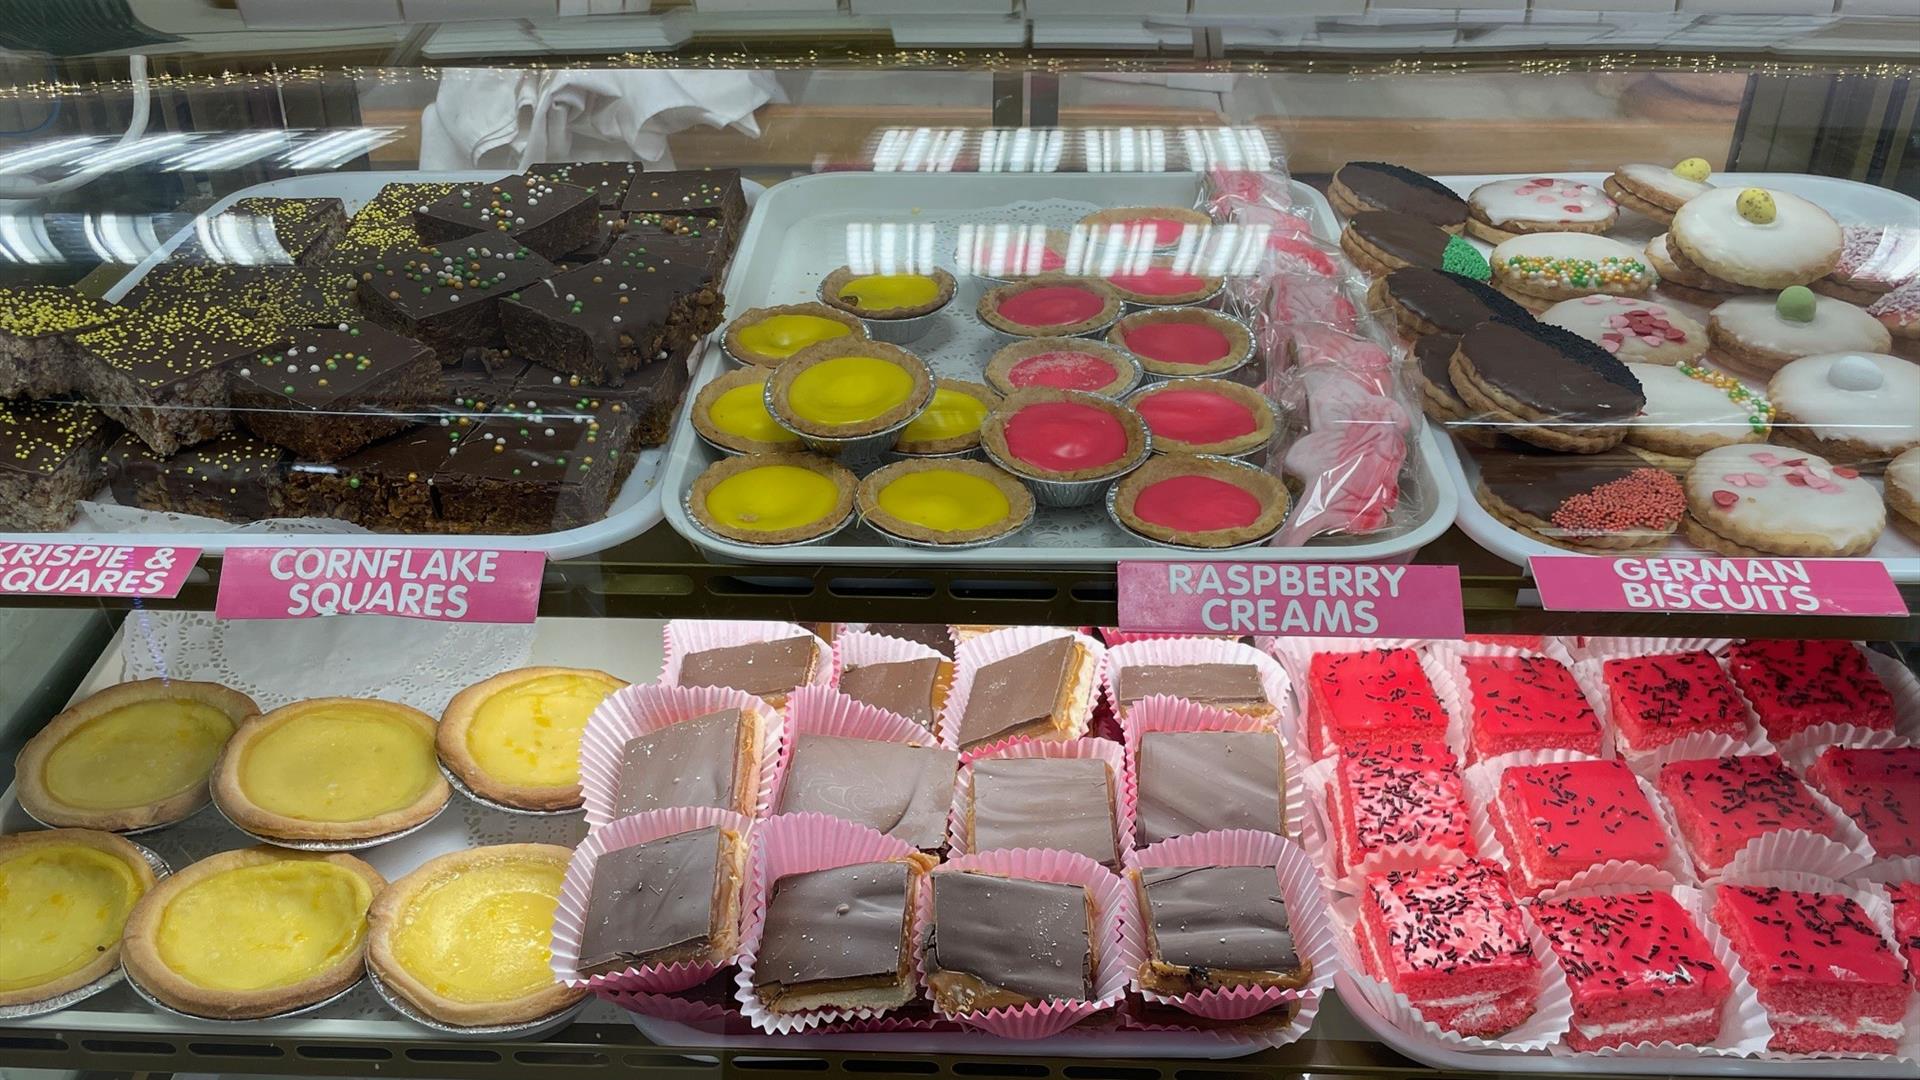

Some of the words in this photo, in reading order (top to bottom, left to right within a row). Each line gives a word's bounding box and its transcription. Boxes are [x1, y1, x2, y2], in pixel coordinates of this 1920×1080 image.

[145, 547, 176, 569] &
[270, 548, 498, 582] CORNFLAKE
[1612, 558, 1810, 583] GERMAN
[0, 566, 168, 593] QUARES
[1169, 564, 1406, 596] RASPBERRY
[287, 582, 469, 618] SQUARES
[1622, 583, 1820, 611] BISCUITS
[1201, 599, 1379, 634] CREAMS
